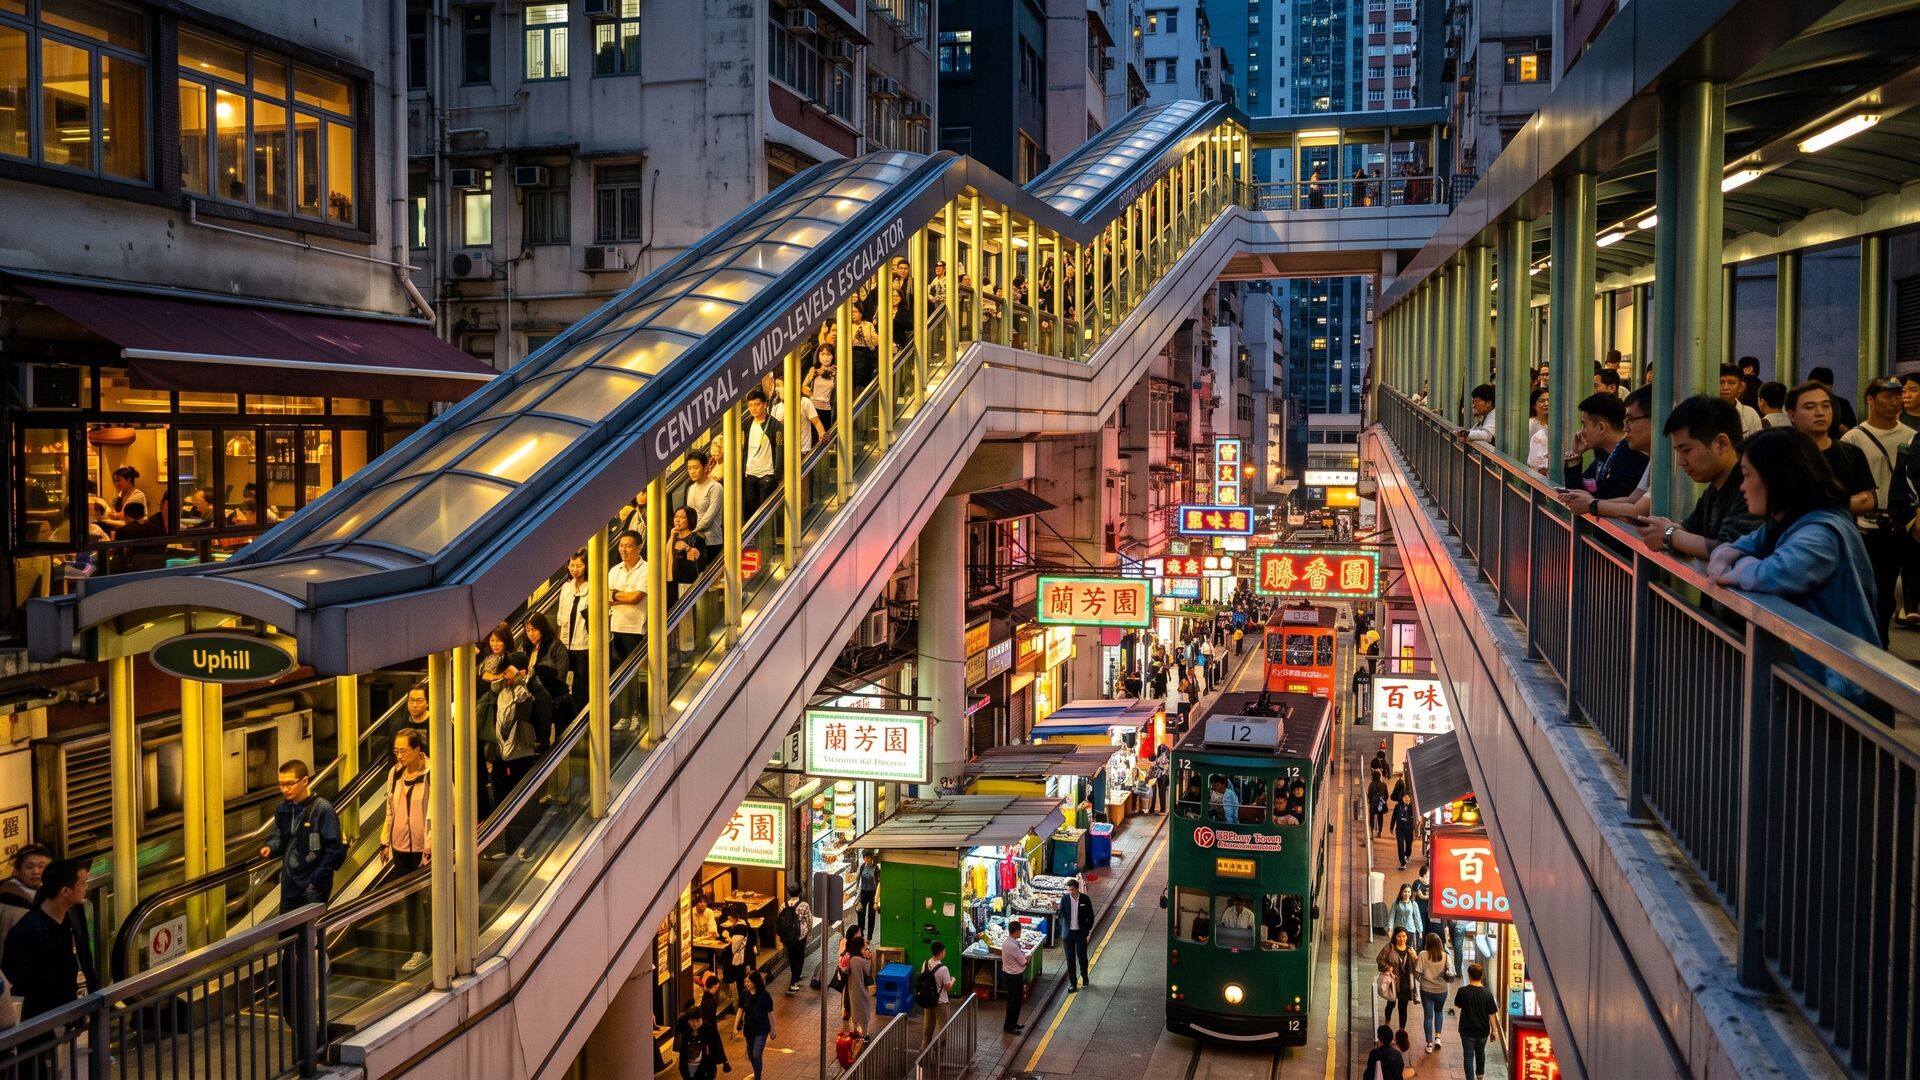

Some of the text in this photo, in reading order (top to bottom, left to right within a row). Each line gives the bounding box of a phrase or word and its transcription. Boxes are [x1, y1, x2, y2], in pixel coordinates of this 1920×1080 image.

[655, 368, 738, 460] CENTRAL
[751, 278, 835, 375] MID-LEVELS
[838, 217, 905, 297] ESCALATOR
[1051, 585, 1137, 618] 蘭芳園
[193, 650, 250, 673] Uphill
[1381, 684, 1443, 711] 百味
[824, 723, 907, 754] 蘭芳園
[1231, 725, 1251, 742] 12
[1179, 759, 1191, 769] 12
[1287, 767, 1300, 777] 12
[1450, 848, 1500, 884] 百
[1441, 887, 1510, 912] SoHo
[1288, 1020, 1300, 1031] 12
